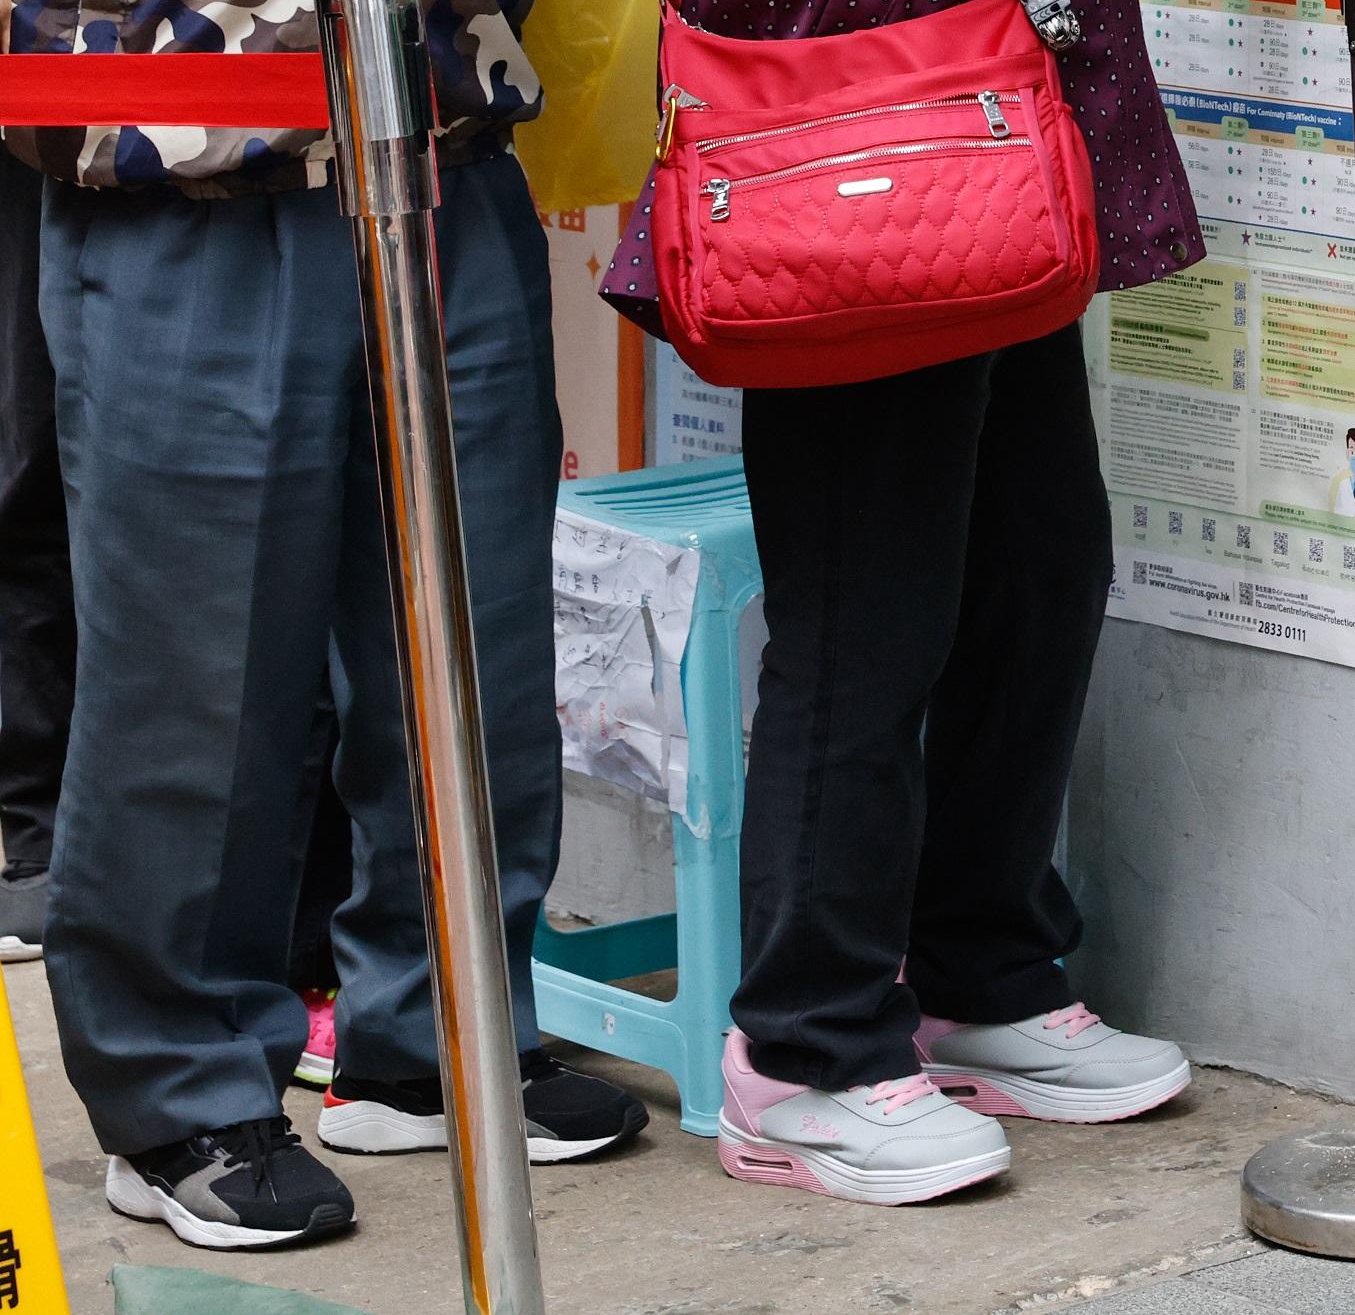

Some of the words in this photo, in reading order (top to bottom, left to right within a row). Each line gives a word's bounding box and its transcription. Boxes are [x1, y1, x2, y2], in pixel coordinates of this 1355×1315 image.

[1149, 579, 1230, 601] www.coronavirus.gov.hk
[1258, 620, 1282, 637] 2833
[1285, 626, 1306, 642] 0111
